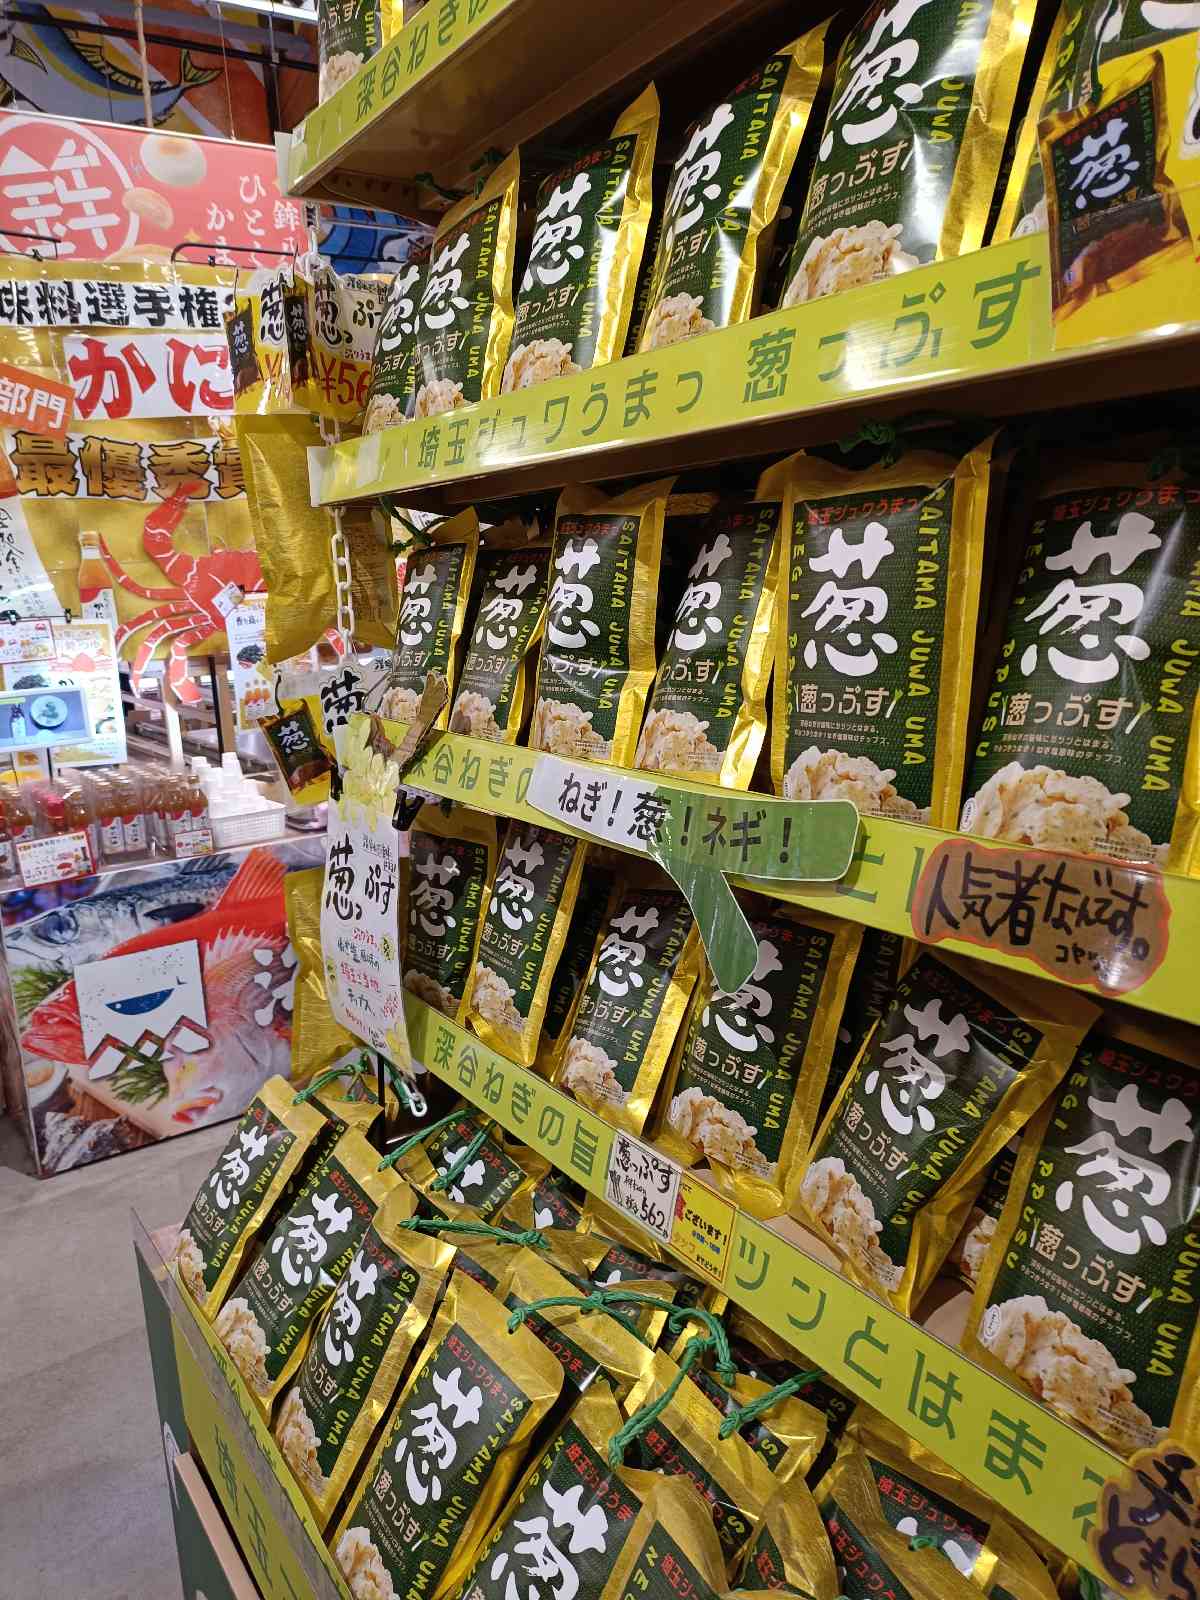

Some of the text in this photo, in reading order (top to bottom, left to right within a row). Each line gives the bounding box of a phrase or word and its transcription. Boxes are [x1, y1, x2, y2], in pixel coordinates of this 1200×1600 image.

[366, 11, 376, 46] UMA
[740, 61, 783, 160] SAITAMA
[666, 103, 734, 250] 葱
[1069, 117, 1140, 210] 葱
[520, 172, 591, 291] 葱
[315, 271, 381, 345] 葱っぷ
[414, 233, 470, 334] 葱
[467, 203, 498, 378] SAITAMA JUWA UMA
[68, 337, 235, 420] かに
[417, 368, 704, 472] 埼玉ジュワうまっ
[742, 258, 1042, 403] 葱っぷす
[806, 496, 920, 526] 埼玉ジュワうまっ
[434, 619, 448, 656] JUWA
[475, 563, 538, 650] 葱
[547, 537, 601, 650] 葱
[598, 520, 637, 711] SAITAMA JUWA UMA
[667, 533, 733, 651] 葱
[714, 508, 776, 718] SAITAMA JUWA UMA
[800, 521, 899, 677] 葱
[903, 486, 946, 765] SAITAMA JUWA UMA
[1021, 511, 1162, 684] 葱
[499, 673, 513, 703] UMA
[800, 684, 890, 717] 葱っぷす
[976, 638, 1017, 758] PPUSU
[1007, 692, 1134, 732] 葱っぷす
[1157, 638, 1200, 715] JUWA
[1141, 735, 1177, 793] UMA
[410, 852, 461, 937] 葱
[457, 846, 486, 953] SAITAMA JUWA
[490, 836, 545, 930] 葱
[520, 837, 576, 992] SAITAMA JUWA UMA
[590, 905, 660, 996] 葱
[623, 900, 693, 1063] AITAMA JUWA UMA
[693, 1036, 762, 1085] 葱っぷす
[763, 935, 828, 1130] SAITAMA JUWA UMA
[865, 998, 972, 1135] 葱
[961, 1028, 1035, 1120] SAITAMA
[430, 1024, 599, 1177] 深谷ねぎの旨
[843, 1100, 910, 1173] 葱っぷす
[209, 1125, 268, 1210] 葱
[616, 1137, 673, 1194] 葱っぷす
[920, 1126, 967, 1182] JUWA
[1004, 1052, 1092, 1270] NEGI PPUSU
[1055, 1083, 1194, 1255] 葱
[209, 1135, 293, 1268] SAITAMA JUWA UMA
[272, 1192, 353, 1287] 葱
[890, 1189, 926, 1226] UMA
[298, 1283, 330, 1319] JUWA
[321, 1249, 378, 1366] 葱
[371, 1270, 416, 1347] SAITAMA
[1033, 1222, 1147, 1305] 葱っぷす
[276, 1325, 300, 1356] UMA
[346, 1355, 374, 1401] JUWA
[1146, 1321, 1184, 1377] UMA
[326, 1409, 351, 1447] UMA
[394, 1366, 483, 1506] 葱
[374, 1468, 422, 1545] 葱っぷす
[405, 1397, 525, 1600] SAITAMA JUWA UMA
[490, 1480, 609, 1600] 葱
